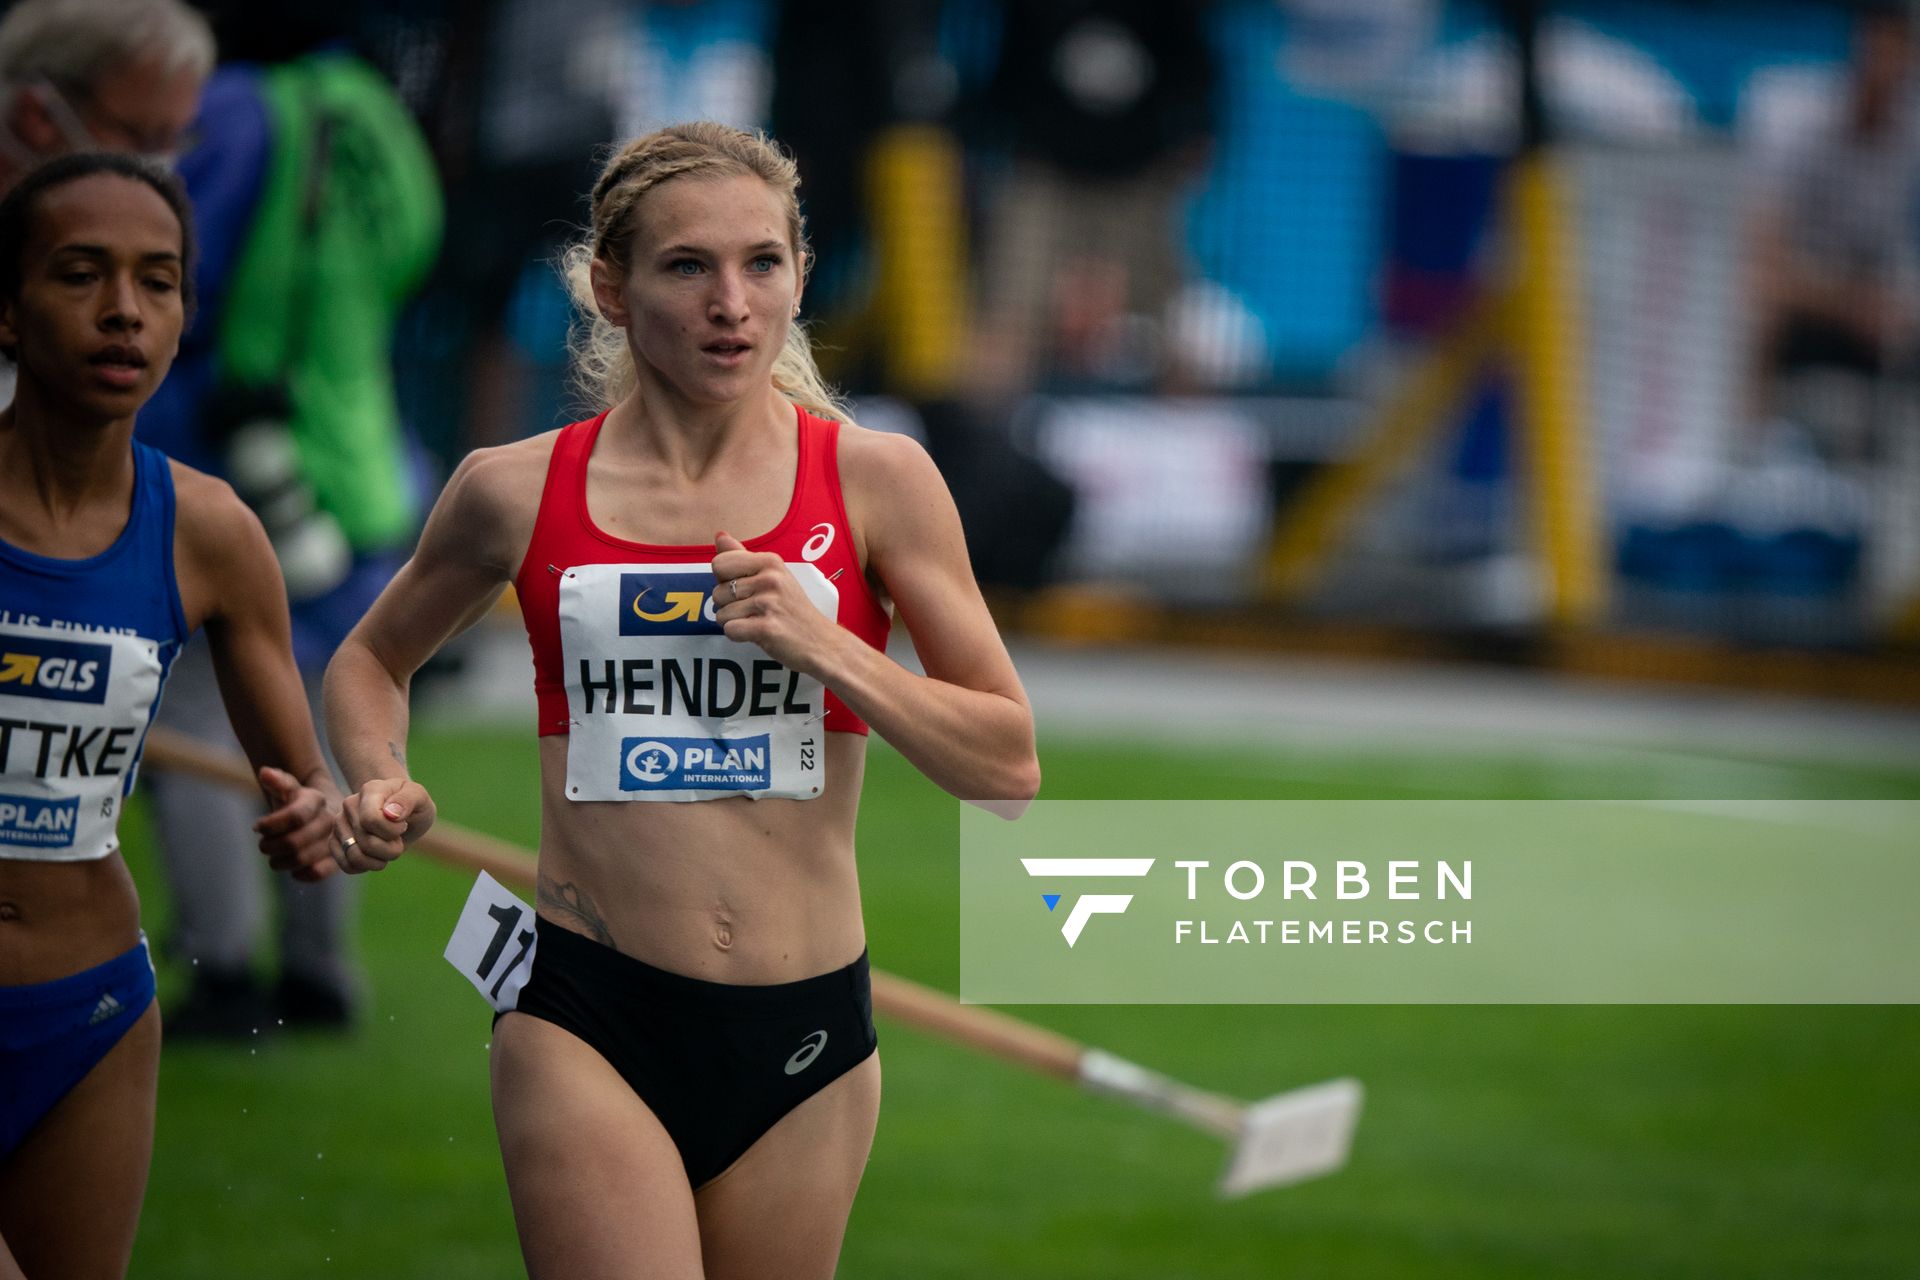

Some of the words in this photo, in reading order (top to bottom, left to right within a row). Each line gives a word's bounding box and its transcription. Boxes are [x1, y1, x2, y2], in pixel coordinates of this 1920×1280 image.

[38, 658, 98, 691] GLS
[580, 657, 810, 718] HENDEL
[0, 718, 136, 778] TTKE
[684, 747, 764, 770] PLAN
[801, 738, 814, 771] 122
[684, 773, 765, 783] INTERNATIONAL
[0, 803, 74, 831] PLAN
